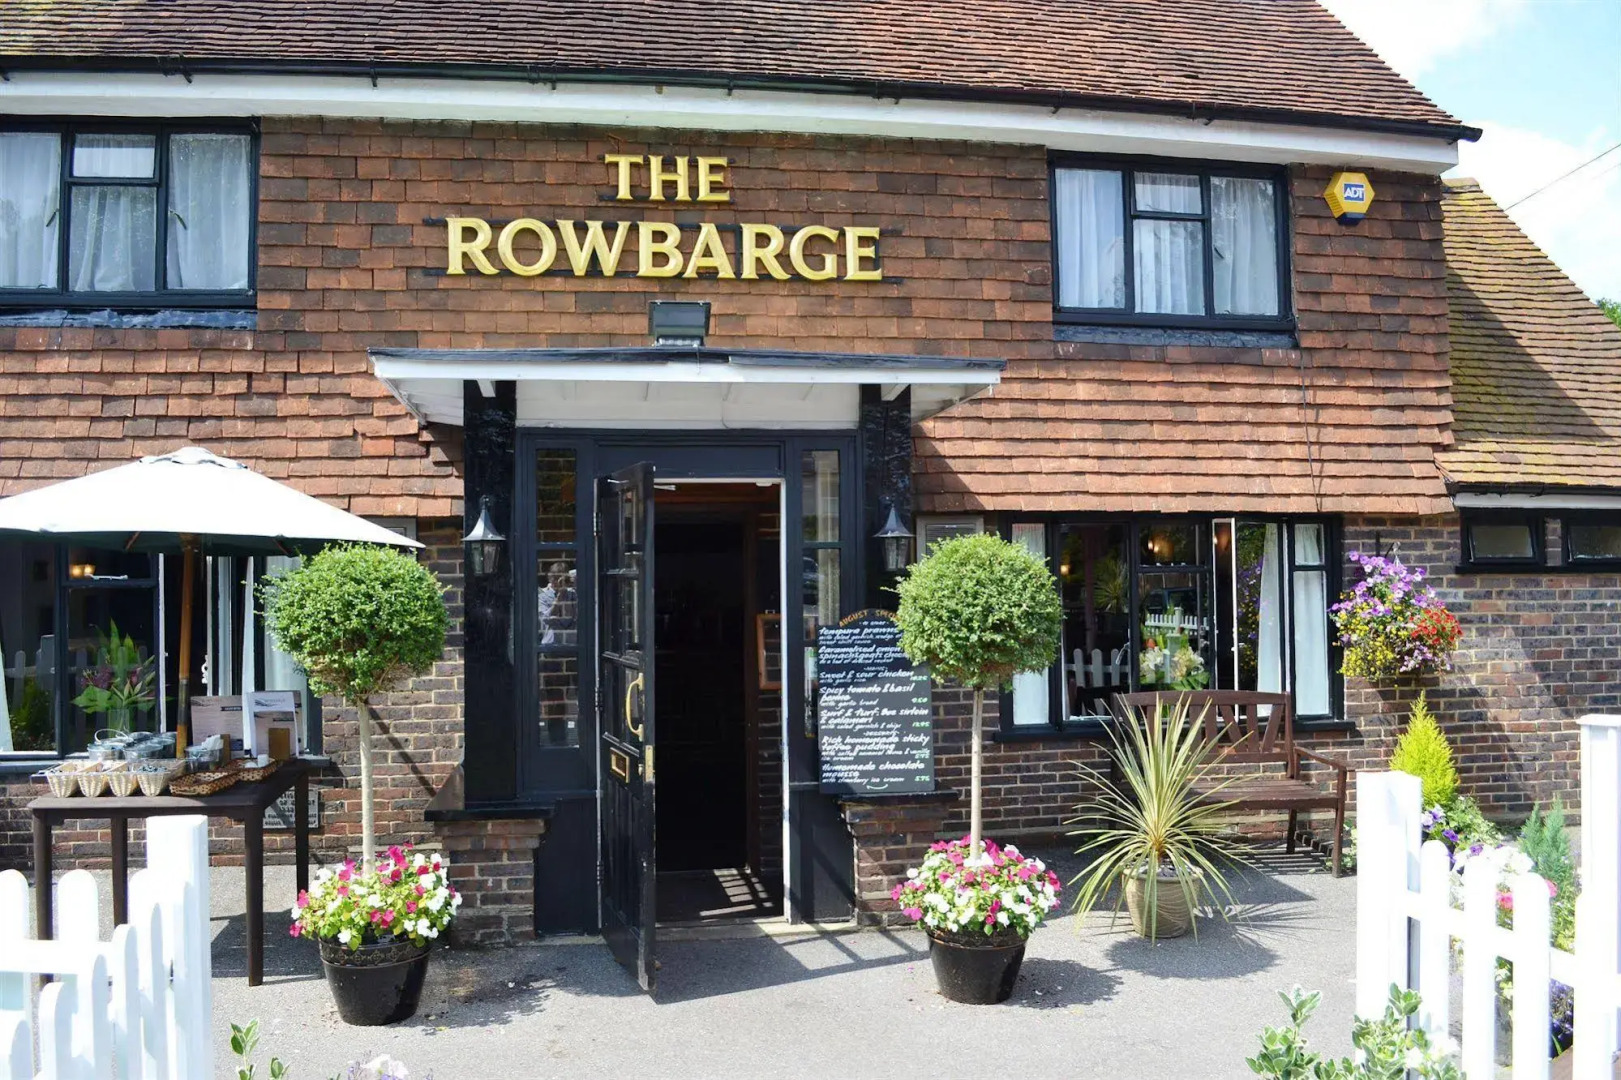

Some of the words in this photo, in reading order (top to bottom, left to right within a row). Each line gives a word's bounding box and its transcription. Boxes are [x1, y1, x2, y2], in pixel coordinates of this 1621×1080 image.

[604, 153, 730, 203] THE
[1344, 187, 1364, 198] ADT
[445, 217, 882, 282] ROWBARGE
[839, 610, 868, 627] AUGUST
[847, 684, 881, 693] tomato
